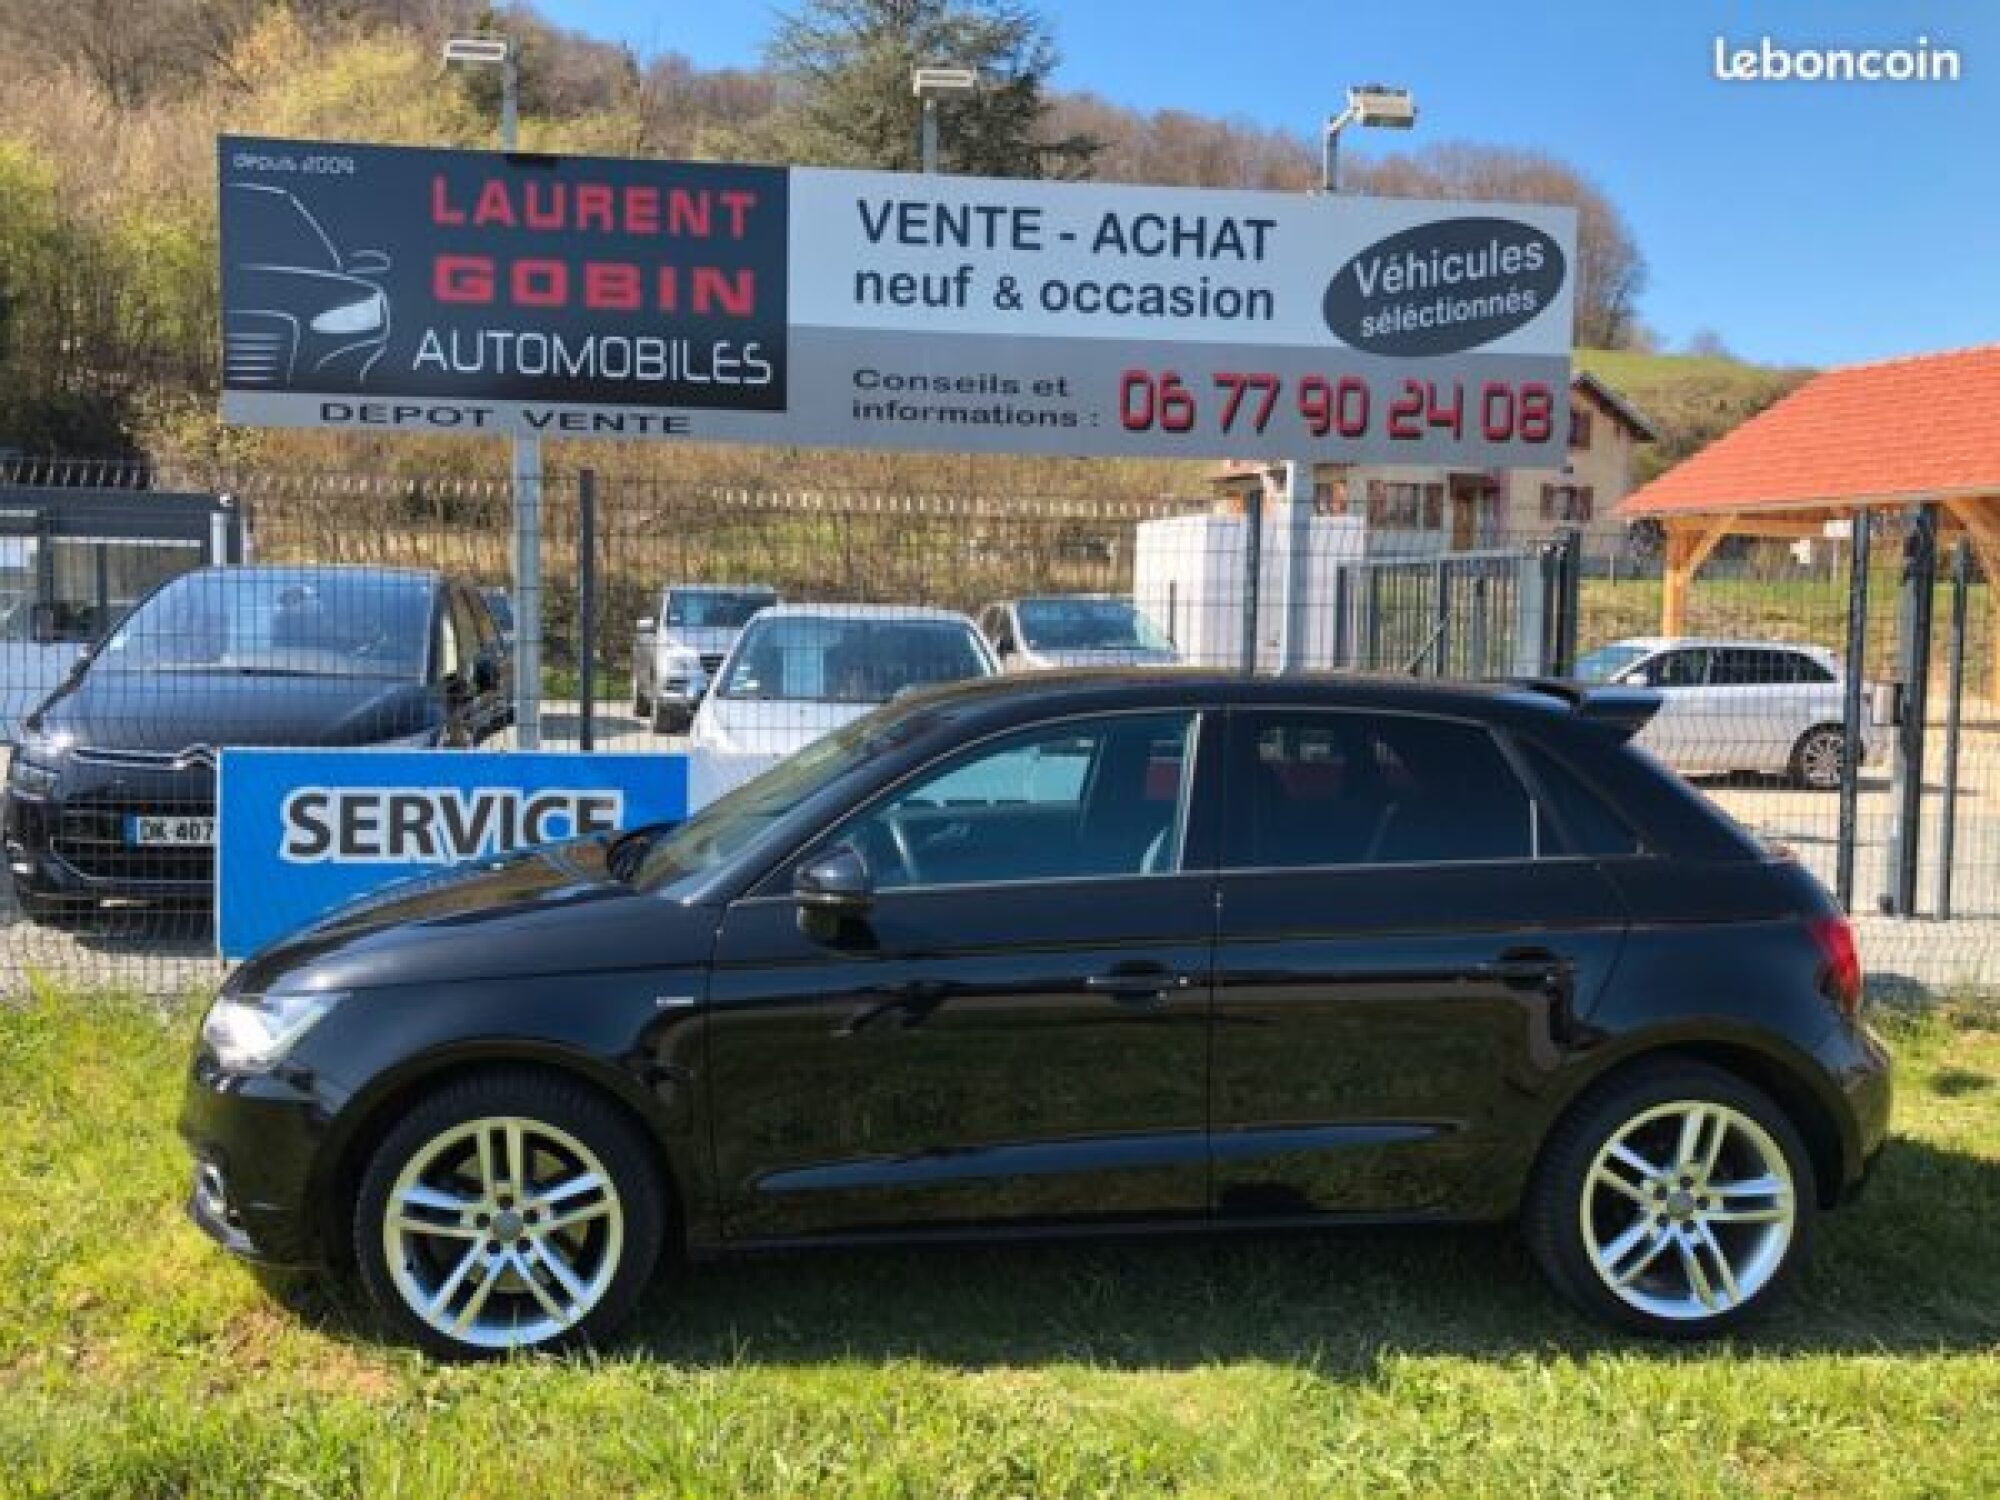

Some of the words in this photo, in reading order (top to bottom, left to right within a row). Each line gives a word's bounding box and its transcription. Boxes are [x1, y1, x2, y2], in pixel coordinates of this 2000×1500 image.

[431, 175, 758, 238] LAURENT
[857, 199, 1044, 251] VENTE
[1092, 211, 1278, 261] ACHAT
[432, 254, 756, 316] GOBIN
[855, 264, 975, 308] neuf
[993, 274, 1024, 311] &
[1040, 276, 1275, 321] occasion
[1353, 239, 1545, 298] Véhicules
[413, 327, 773, 385] AUTOMOBILES
[852, 369, 1022, 394] Conseils
[1032, 376, 1070, 397] et
[319, 402, 495, 428] DEPOT
[522, 409, 692, 435] VENTE
[852, 400, 1077, 427] informations
[1120, 369, 1195, 433] 06
[1213, 372, 1280, 434] 77
[1299, 374, 1370, 438] 90
[1387, 378, 1464, 442] 24
[1480, 381, 1554, 443] 08
[280, 788, 625, 864] SERVICE
